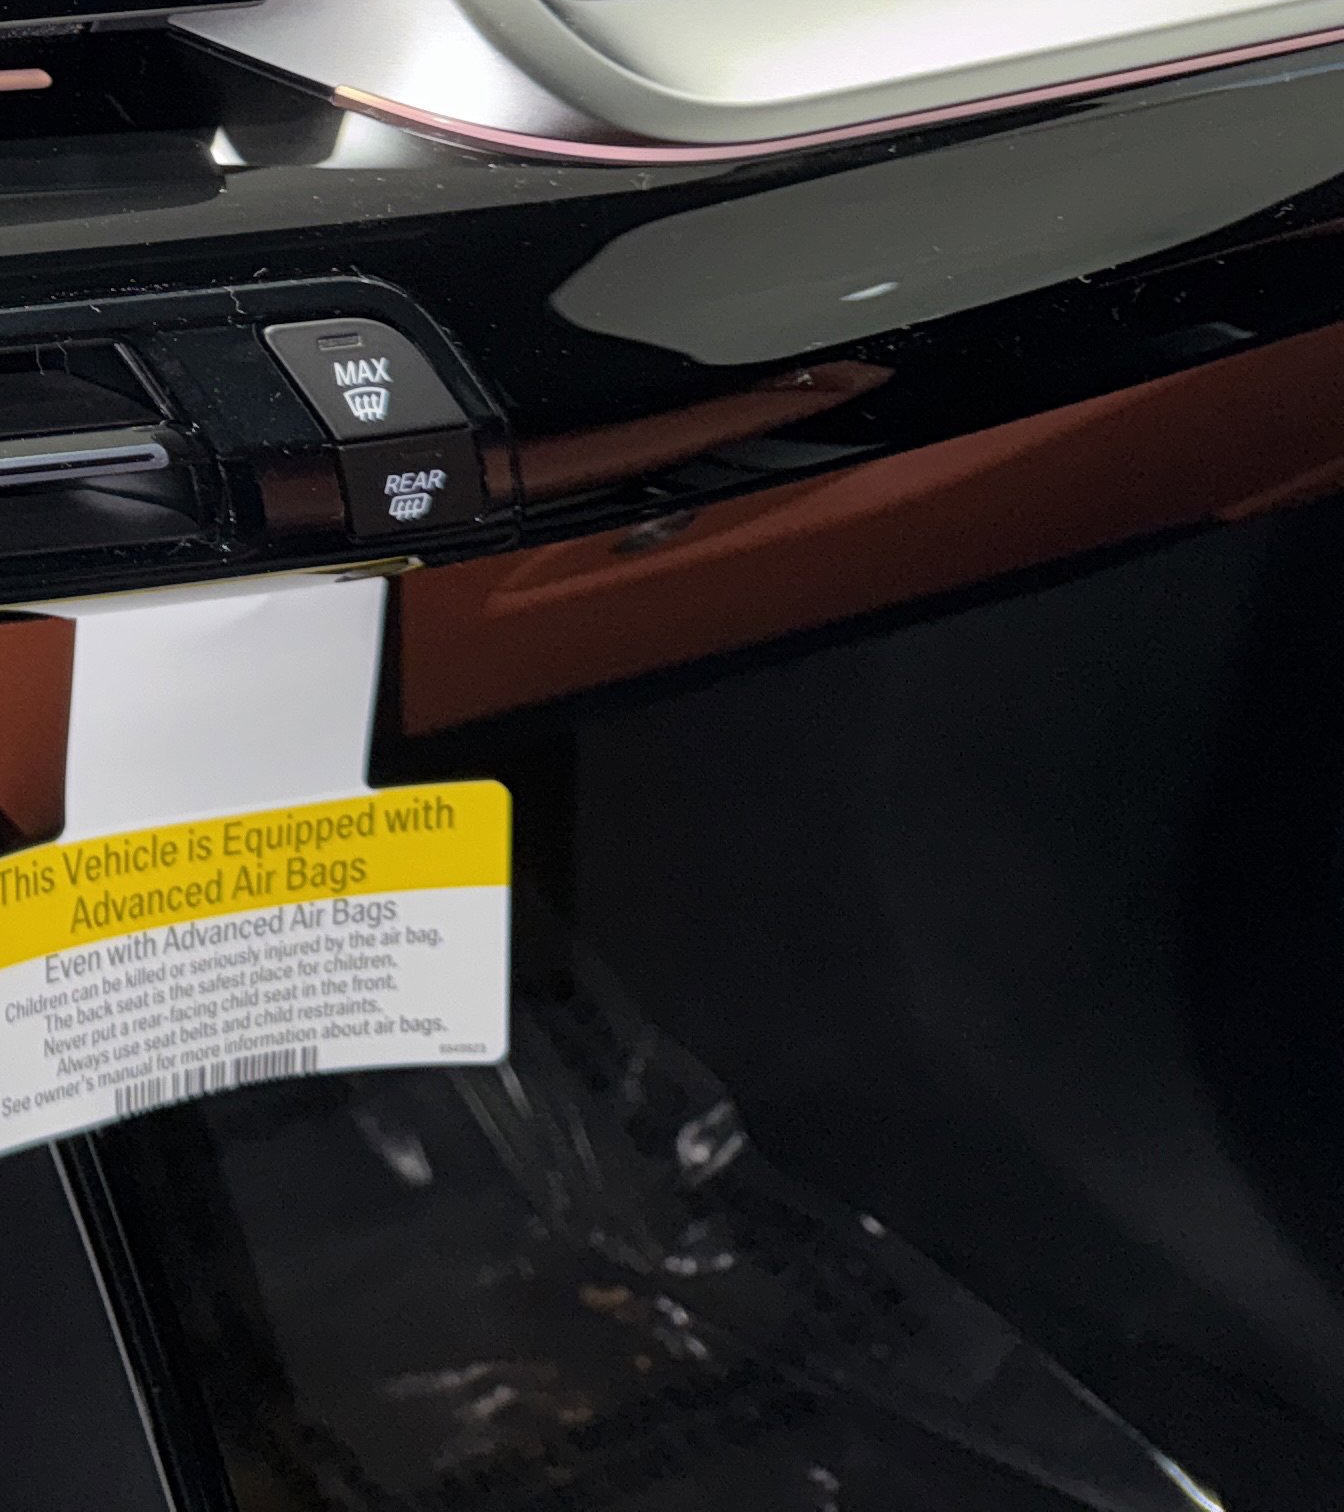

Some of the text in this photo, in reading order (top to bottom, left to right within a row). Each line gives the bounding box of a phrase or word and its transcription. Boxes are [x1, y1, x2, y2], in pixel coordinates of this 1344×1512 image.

[333, 357, 393, 386] MAX
[384, 469, 447, 496] REAR
[63, 834, 178, 886] Vehicle
[188, 829, 211, 862] is
[223, 802, 376, 858] Equipped
[385, 796, 455, 833] with
[71, 856, 368, 933] Advanced Air Bags
[5, 926, 443, 1024] Children can be killed or seriously injured by the air bag.
[46, 898, 397, 984] Even with Advanced Air Bags
[43, 973, 398, 1058] Never put a rear-facing child seat in the front.
[44, 952, 398, 1034] The back seat is the safest place for children.
[2, 1014, 448, 1118] See owner's manual for more information about air bags.
[56, 998, 382, 1078] Always use seat belts and child restraints.
